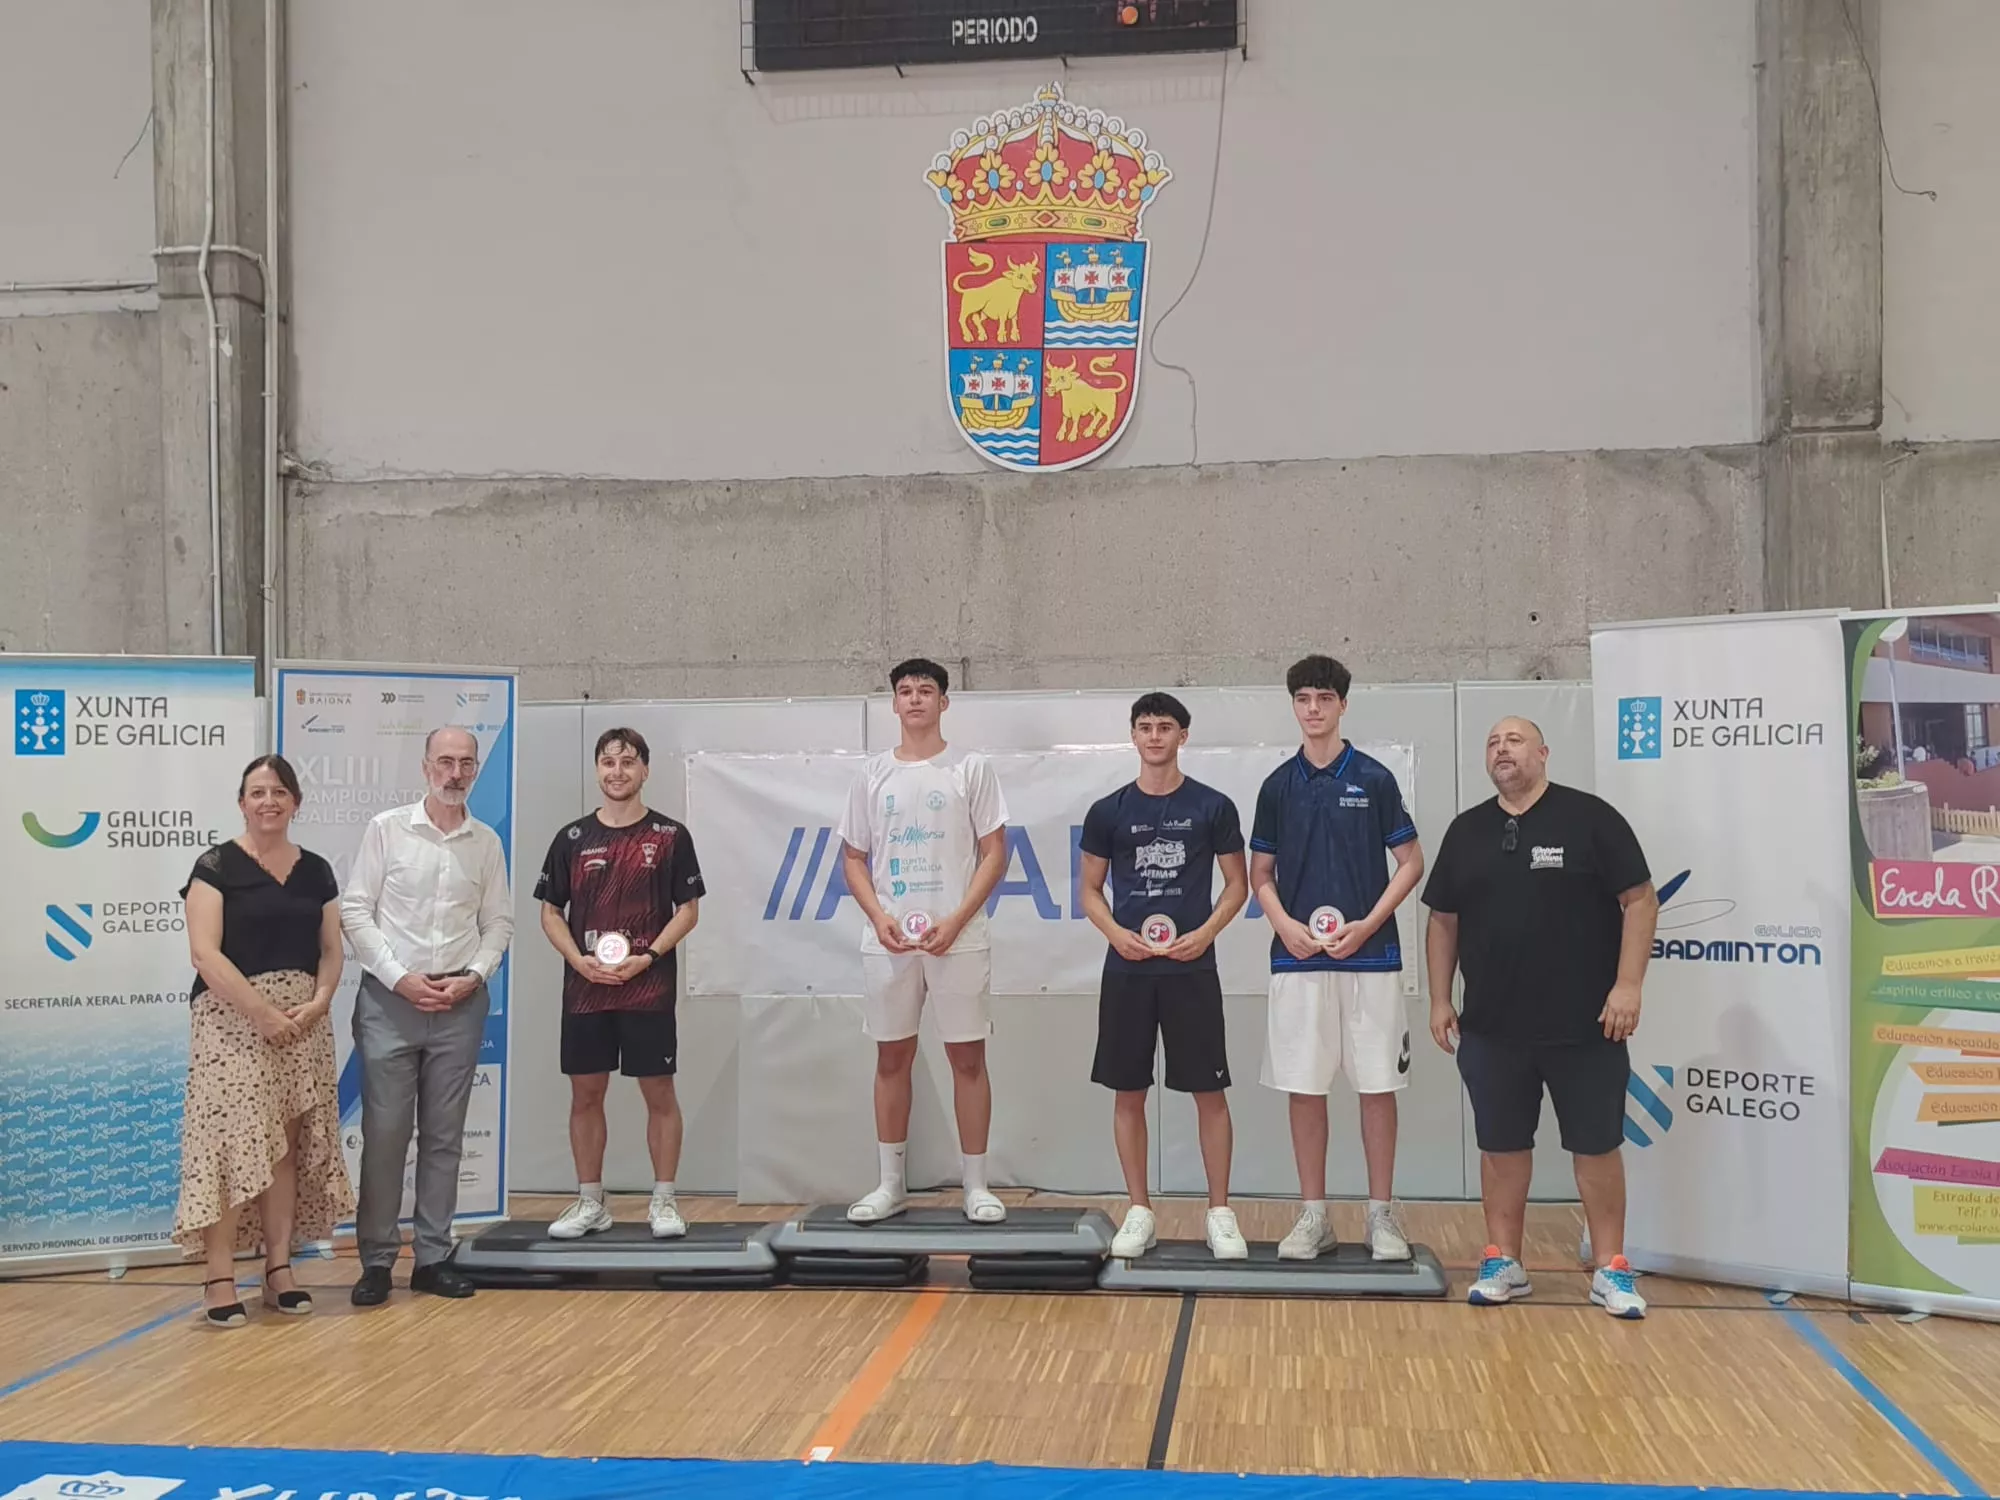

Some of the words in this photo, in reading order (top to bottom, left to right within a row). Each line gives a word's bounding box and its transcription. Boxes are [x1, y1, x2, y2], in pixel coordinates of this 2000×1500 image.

[952, 16, 1038, 45] PERIODO
[76, 696, 168, 718] XUNTA
[1673, 697, 1763, 721] XUNTA
[76, 725, 108, 746] DE
[117, 725, 225, 746] GALICIA
[1673, 727, 1704, 747] DE
[1712, 723, 1823, 746] GALICIA
[297, 755, 381, 785] XLIII
[107, 811, 193, 828] GALICIA
[107, 830, 219, 848] SAUDABLE
[1881, 868, 1966, 908] Escola
[103, 901, 185, 916] DEPORT
[103, 919, 185, 933] GALEGO
[1754, 925, 1821, 938] GALICIA
[5, 995, 82, 1010] SECRETARÍA
[86, 995, 127, 1006] XERAL
[130, 993, 163, 1005] PARA
[166, 993, 176, 1004] O
[1687, 1068, 1815, 1096] DEPORTE
[1686, 1094, 1800, 1122] GALEGO
[1933, 1190, 1981, 1203] Estrada
[2, 1242, 41, 1252] SERVIZO
[42, 1238, 96, 1249] PROVINCIAL
[98, 1236, 110, 1244] DE
[113, 1232, 158, 1243] DEPORTES
